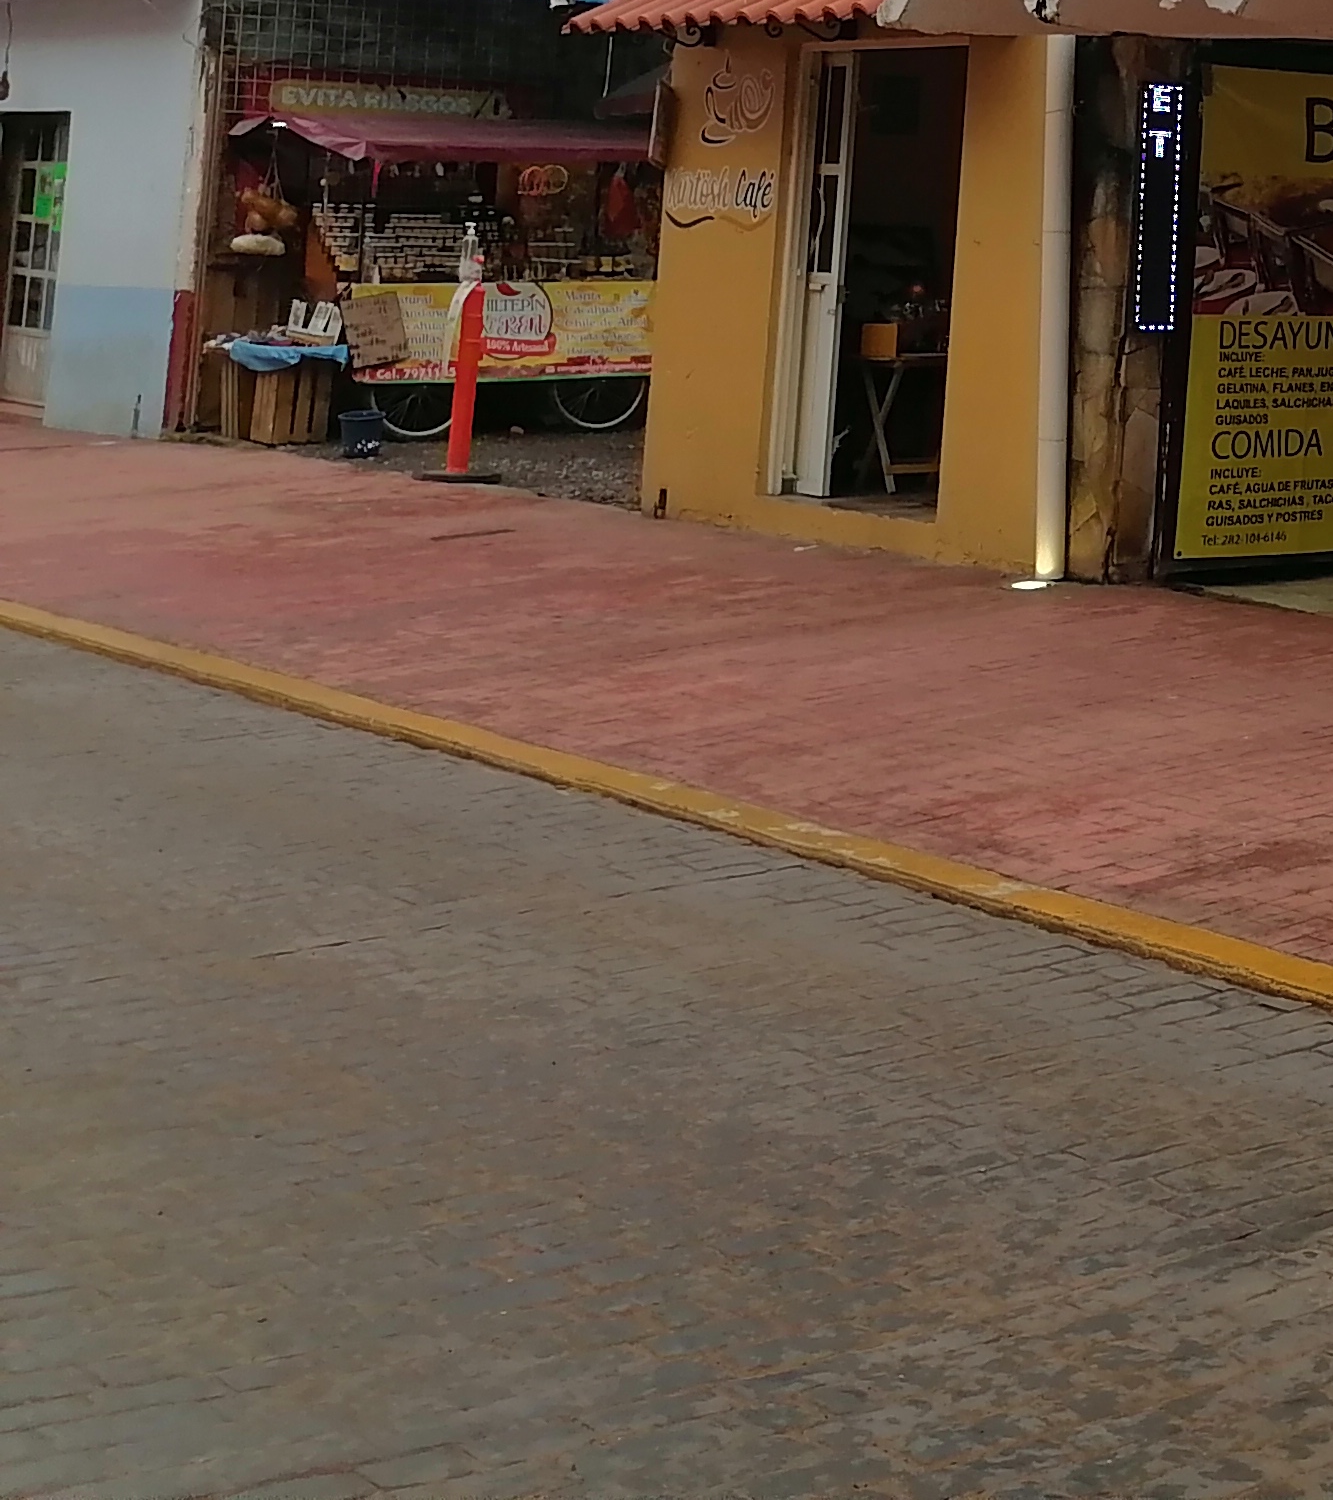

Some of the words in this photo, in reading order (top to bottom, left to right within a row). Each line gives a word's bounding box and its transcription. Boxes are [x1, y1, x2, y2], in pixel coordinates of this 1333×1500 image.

[281, 85, 357, 108] EVITA
[735, 168, 775, 220] Café
[1219, 352, 1265, 362] INCLUYE:
[1217, 383, 1269, 394] GELATINA,
[1273, 382, 1317, 393] FLANES,
[1216, 398, 1269, 409] LAQUILES,
[1216, 414, 1269, 425] GUISADOS
[1212, 428, 1323, 460] COMIDA
[1210, 467, 1262, 479] INCLUYE:
[1209, 482, 1243, 495] CAFÉ,
[1245, 482, 1275, 494] AGUA
[1277, 481, 1291, 491] DE
[1208, 500, 1235, 512] RAS,
[1206, 514, 1264, 527] GUISADOS
[1267, 512, 1273, 523] Y
[1276, 510, 1323, 522] POSTRES
[1202, 534, 1219, 546] Tel:
